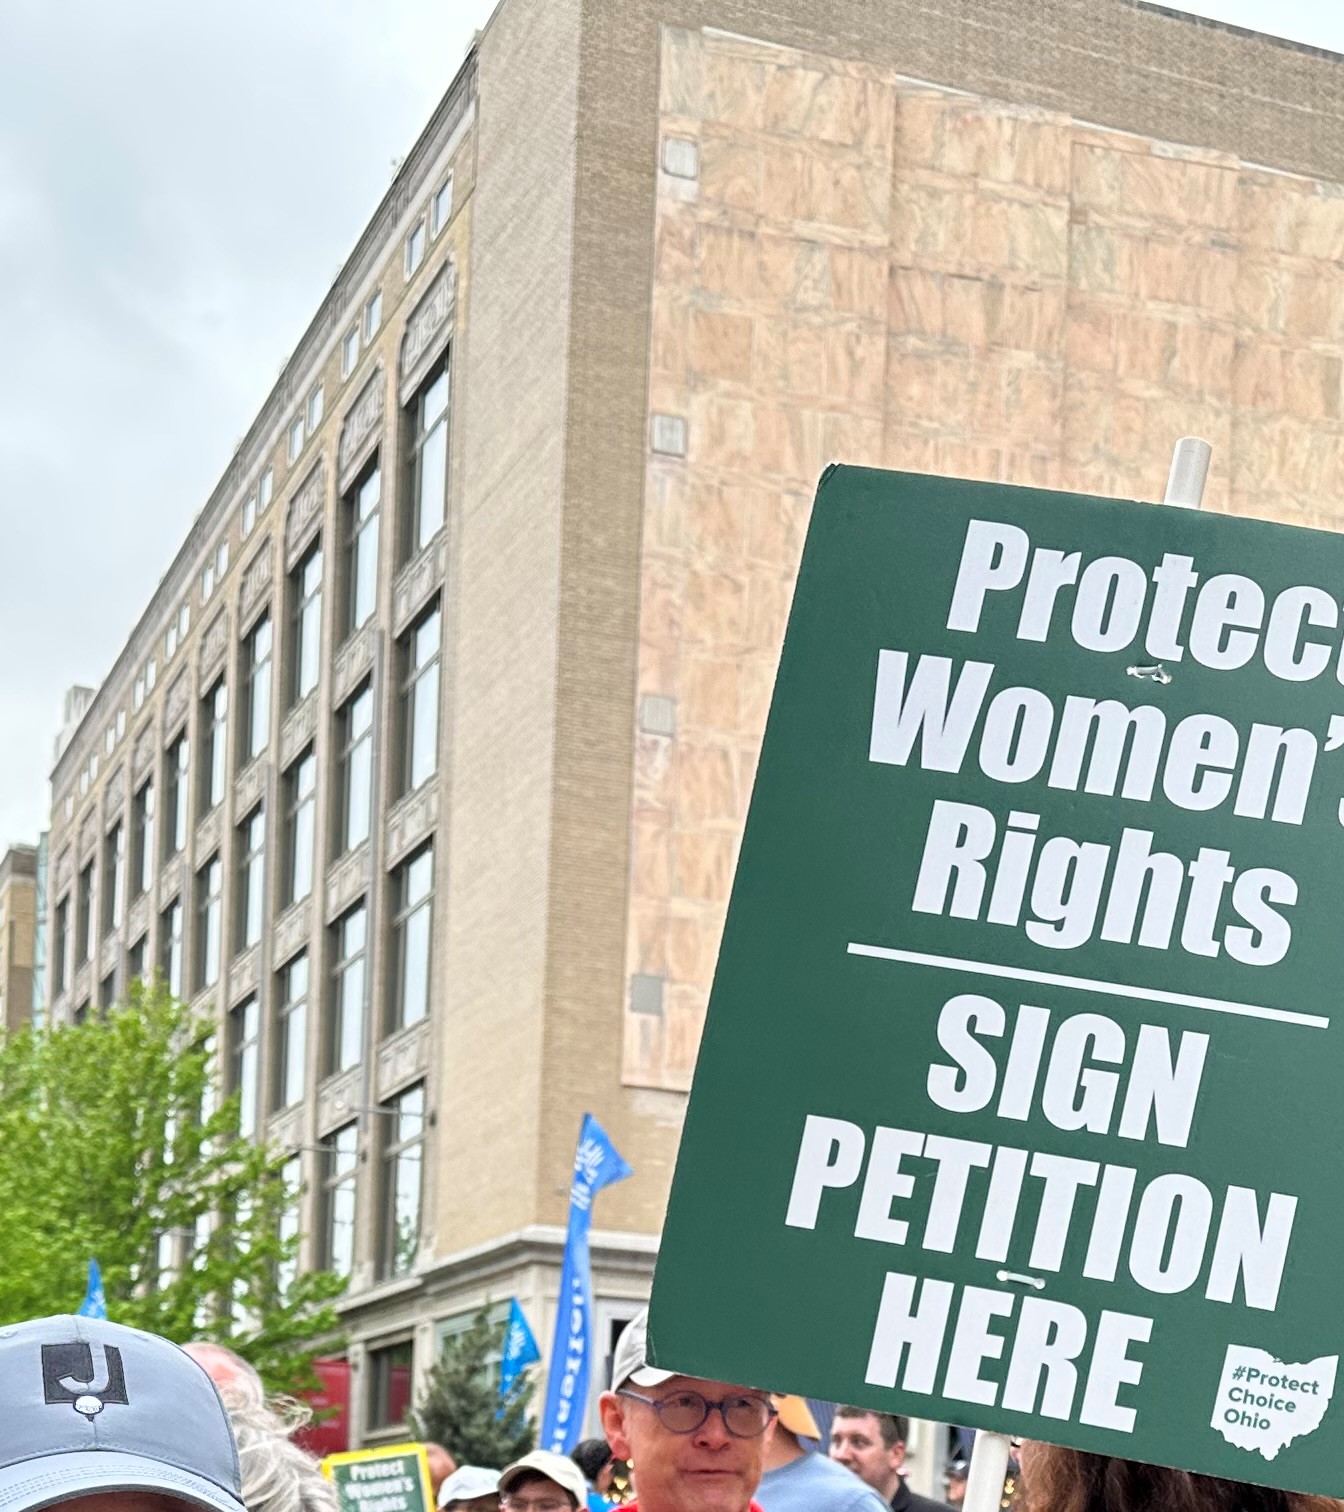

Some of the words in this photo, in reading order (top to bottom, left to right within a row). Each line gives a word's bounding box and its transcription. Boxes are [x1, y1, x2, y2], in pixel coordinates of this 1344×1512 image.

[911, 799, 1299, 967] Rights
[926, 994, 1211, 1149] SIGN
[784, 1114, 1299, 1312] PETITION
[864, 1271, 1154, 1434] HERE
[1232, 1366, 1319, 1395] #Protect
[1224, 1408, 1271, 1430] Ohio
[1228, 1387, 1297, 1413] Choice
[350, 1460, 405, 1481] Protect
